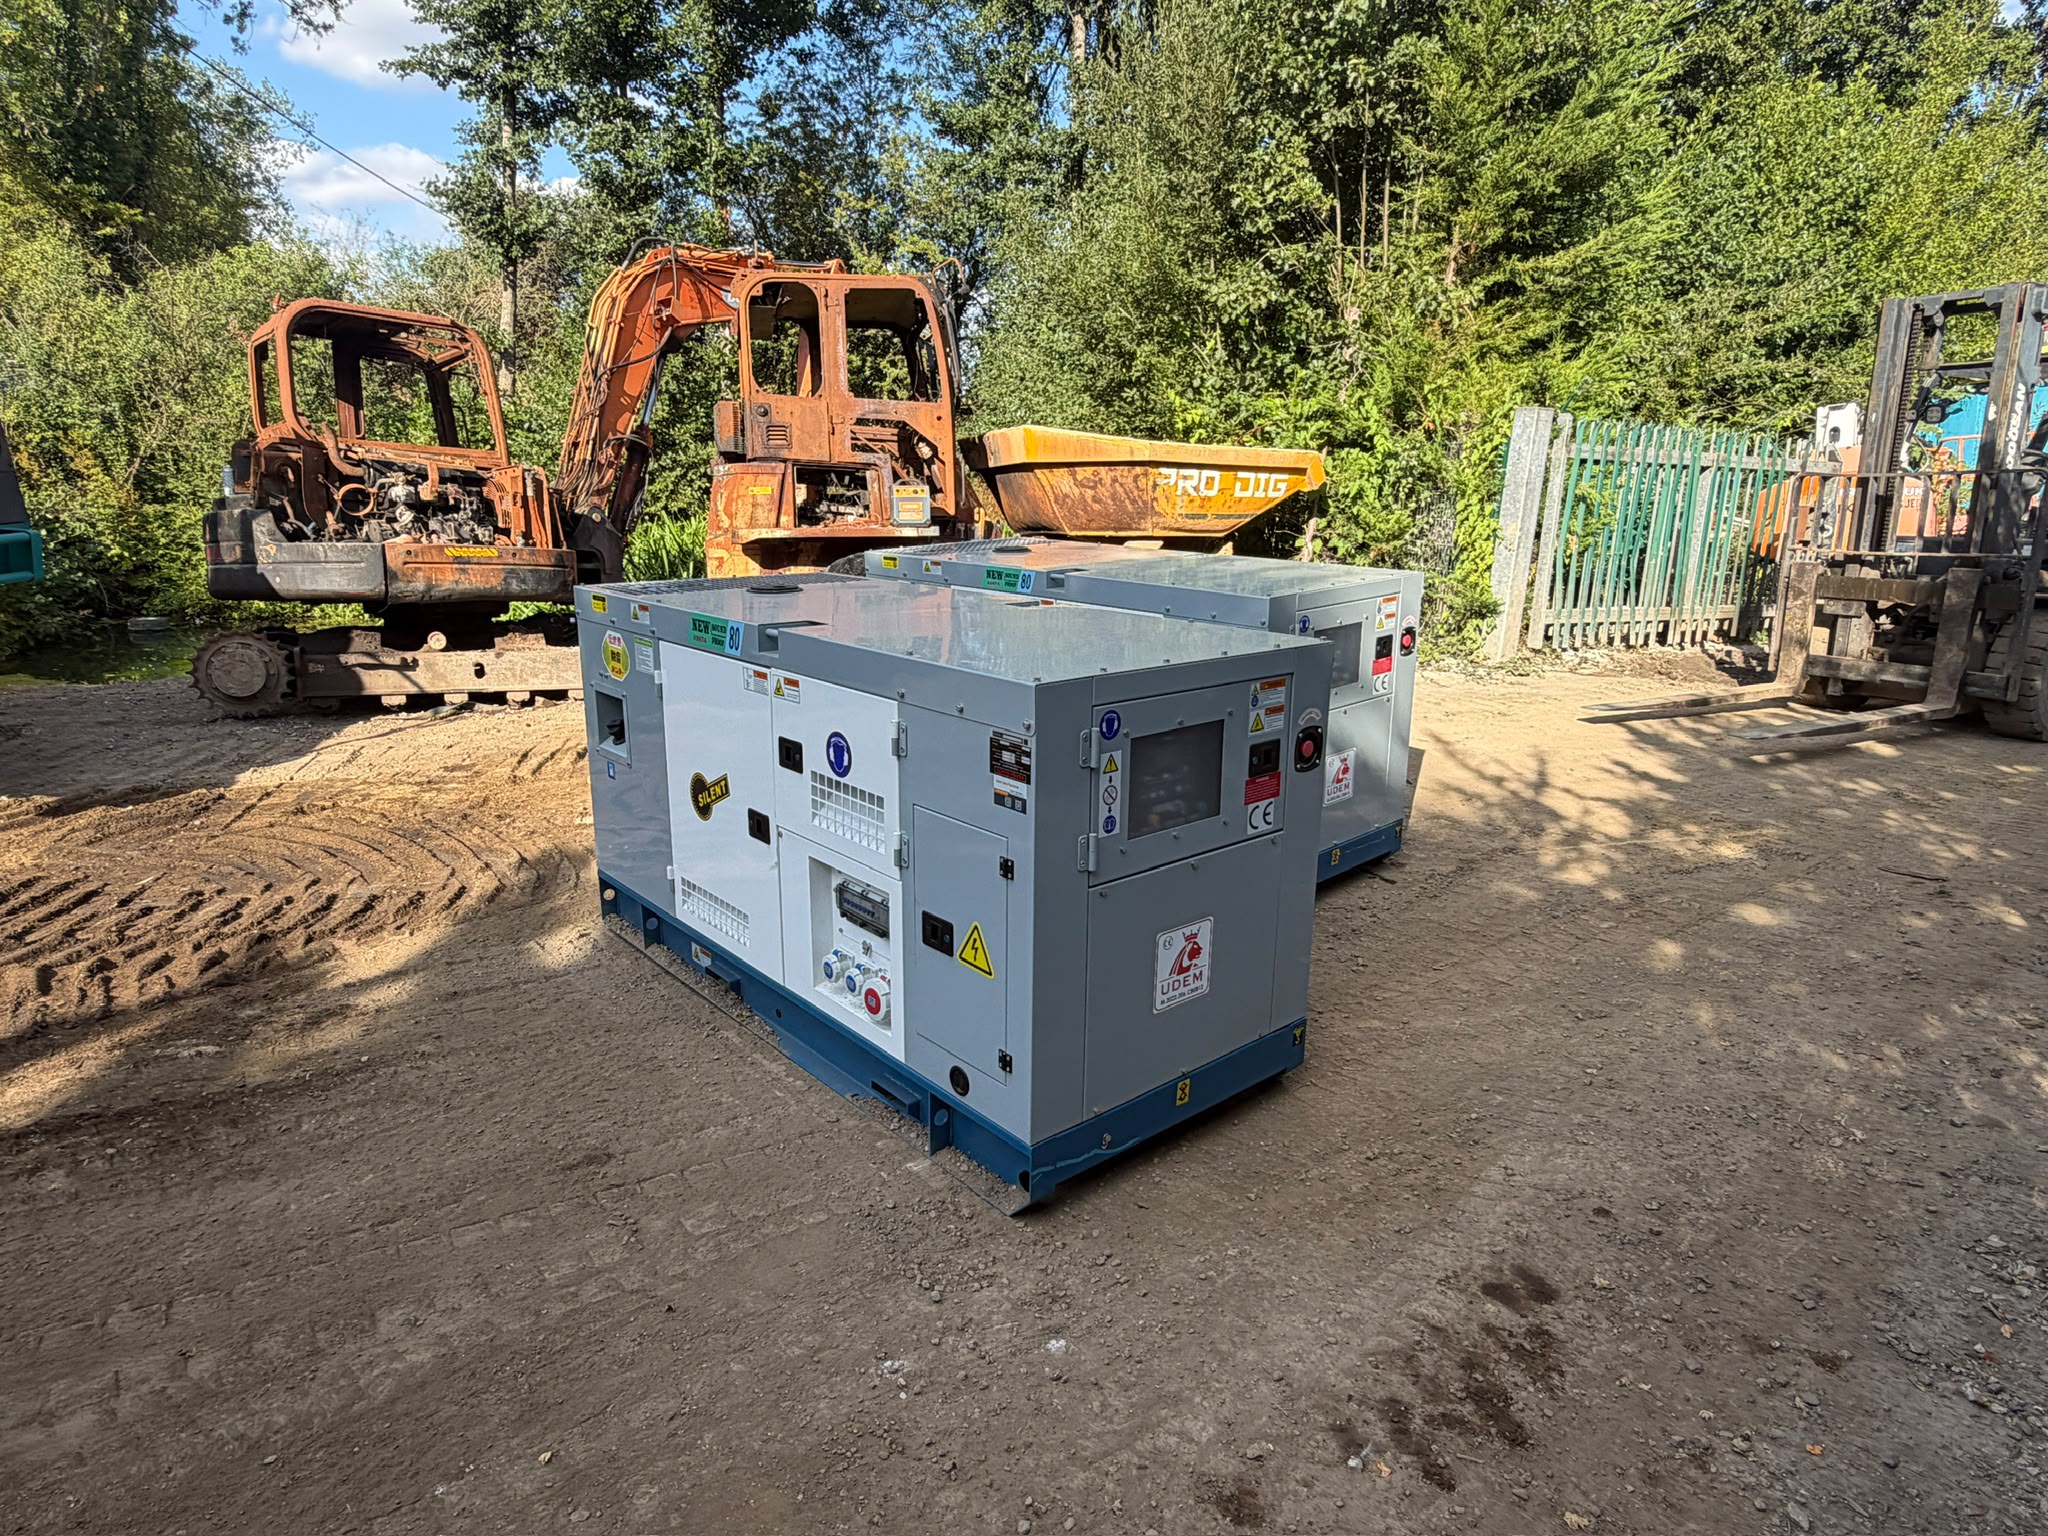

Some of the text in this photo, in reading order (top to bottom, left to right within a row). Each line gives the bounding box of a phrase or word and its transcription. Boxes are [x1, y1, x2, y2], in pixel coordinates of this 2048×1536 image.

[1156, 467, 1289, 498] PRO DIG
[1020, 573, 1032, 590] 80
[691, 617, 711, 635] NEW
[728, 625, 740, 651] 80
[1373, 674, 1389, 693] CE
[697, 780, 726, 807] SILENT
[1327, 781, 1350, 797] UDEM
[1248, 801, 1274, 830] CE
[1160, 969, 1204, 995] UDEM
